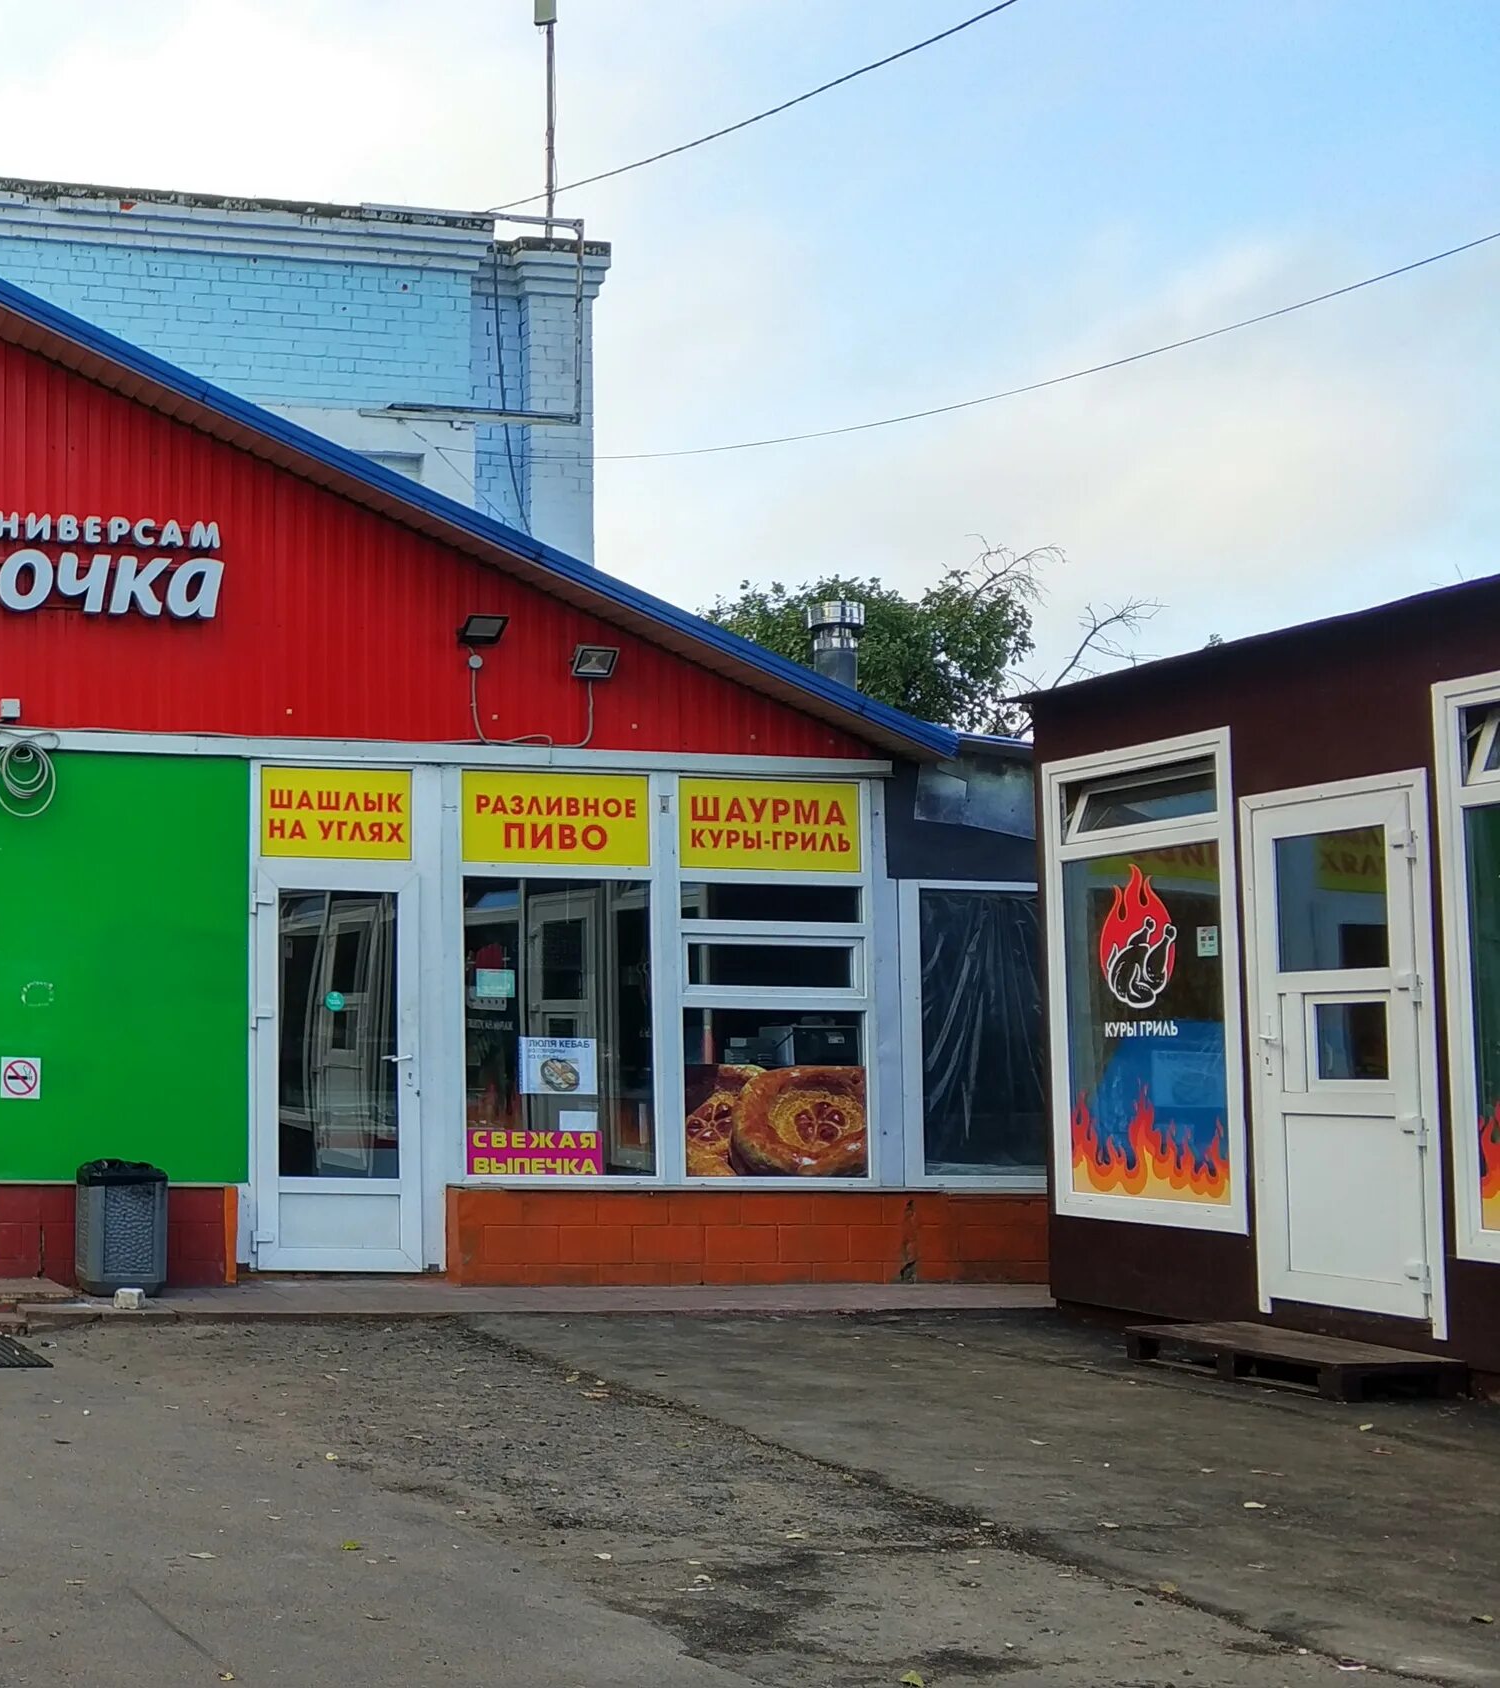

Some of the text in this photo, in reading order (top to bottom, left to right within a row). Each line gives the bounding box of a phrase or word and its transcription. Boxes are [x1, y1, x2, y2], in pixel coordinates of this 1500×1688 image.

[269, 788, 403, 814] ШАШЛЫК
[475, 794, 637, 819] РАЗЛИВНОЕ
[690, 796, 846, 826] ШАУРМА
[268, 819, 404, 843] НА УГЛЯХ
[503, 822, 609, 851] ПИВО
[690, 830, 851, 852] КУРЫ-ГРИЛЬ
[1104, 1020, 1179, 1038] КУРЫ ГРИЛЬ
[528, 1039, 591, 1049] ЛЮЛЯ КЕБАБ
[472, 1130, 598, 1150] СВЕЖАЯ
[472, 1156, 598, 1176] ВЫПЕЧКА
